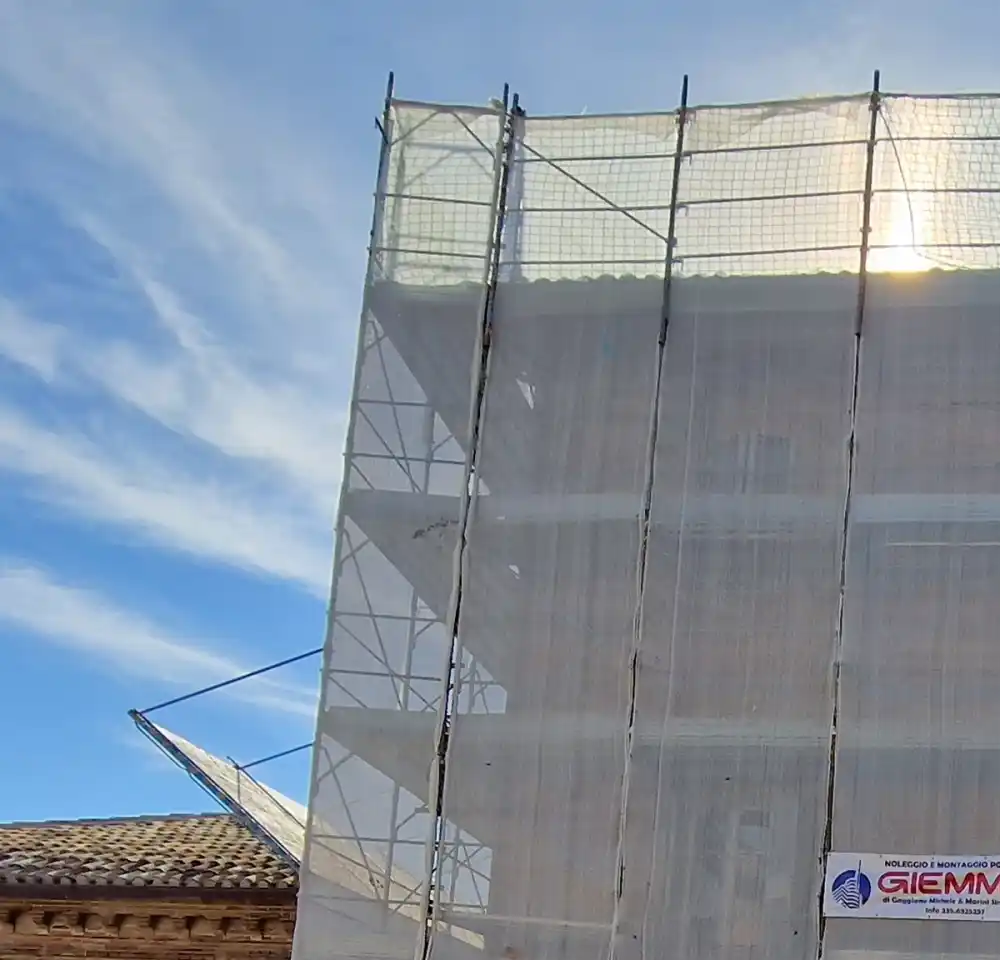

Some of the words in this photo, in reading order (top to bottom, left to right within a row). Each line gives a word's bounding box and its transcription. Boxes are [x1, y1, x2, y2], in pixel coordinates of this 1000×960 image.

[884, 860, 928, 868] NOLEGGIO
[937, 861, 988, 869] MONTAGGIO
[882, 896, 890, 904] di
